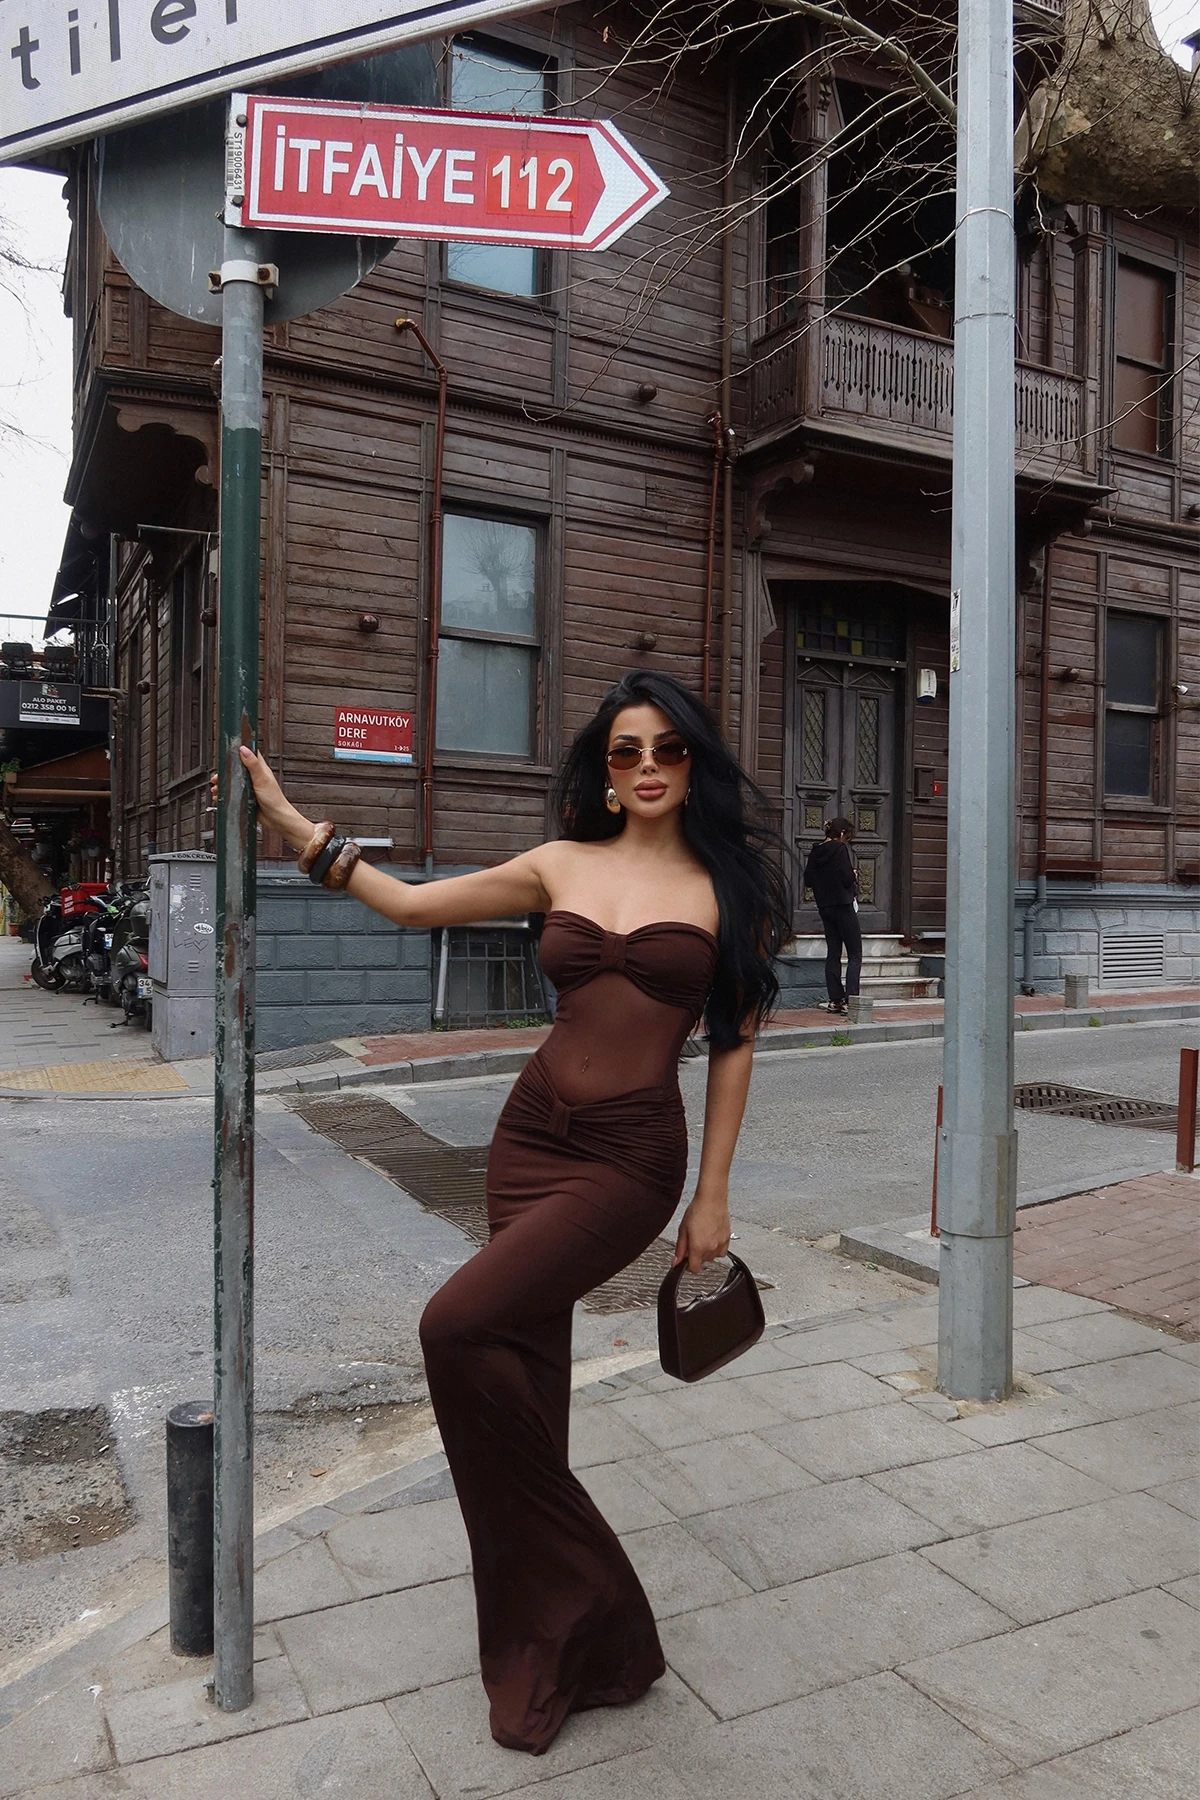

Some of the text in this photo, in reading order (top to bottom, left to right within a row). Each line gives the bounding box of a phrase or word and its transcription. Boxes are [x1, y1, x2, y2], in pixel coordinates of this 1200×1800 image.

[233, 132, 243, 190] ST19006431
[273, 124, 575, 212] İTFAİYE 112
[68, 705, 77, 713] 16
[338, 712, 410, 728] ARNAVUTKÖY
[338, 727, 368, 739] DERE
